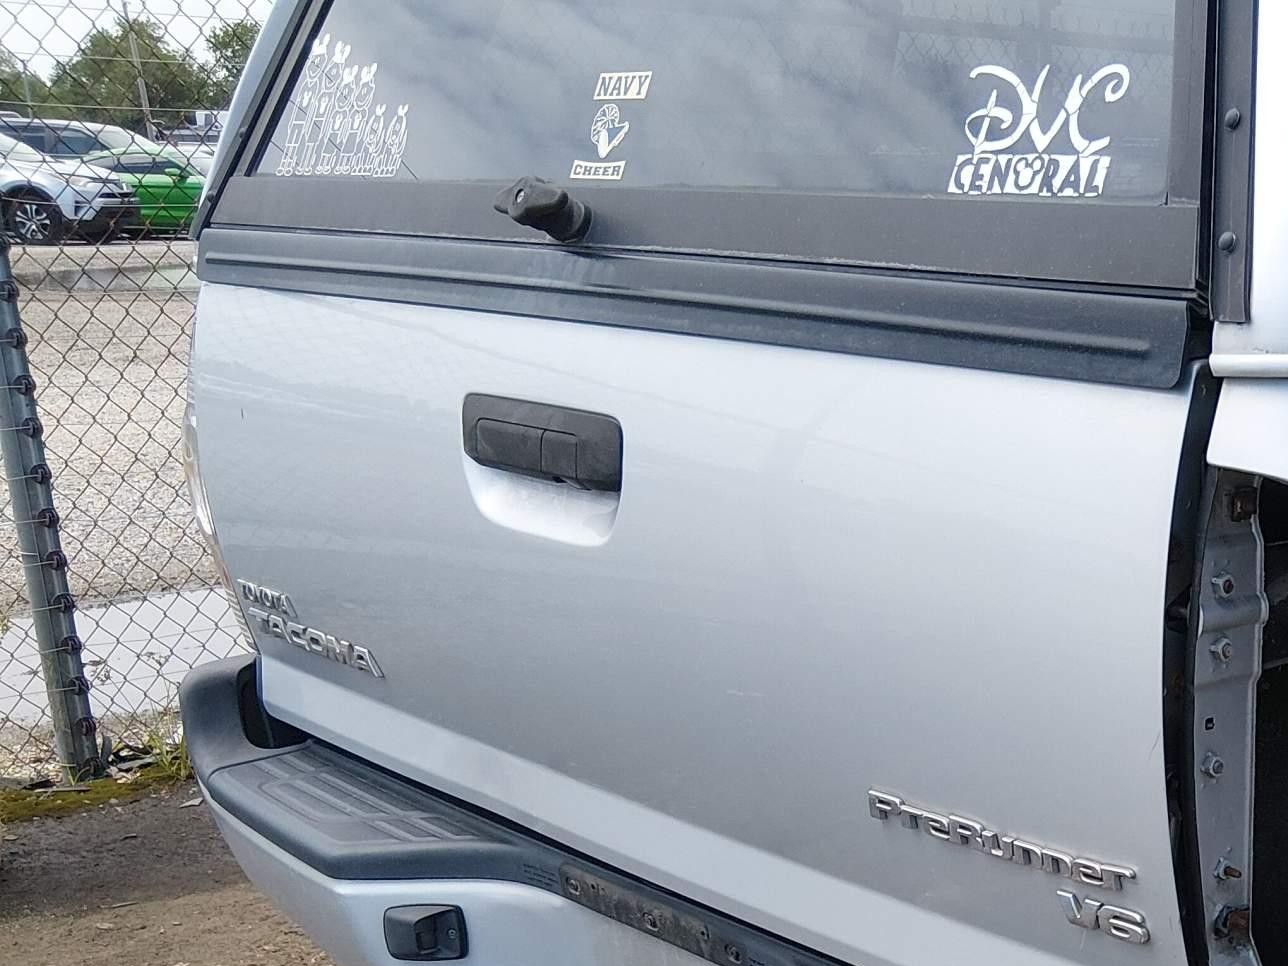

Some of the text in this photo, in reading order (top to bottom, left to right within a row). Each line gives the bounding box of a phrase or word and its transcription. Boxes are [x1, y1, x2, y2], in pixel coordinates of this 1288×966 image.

[596, 74, 651, 98] NAVY
[572, 163, 623, 178] CHEER
[247, 607, 385, 679] TACOMA
[1056, 889, 1151, 945] V6
